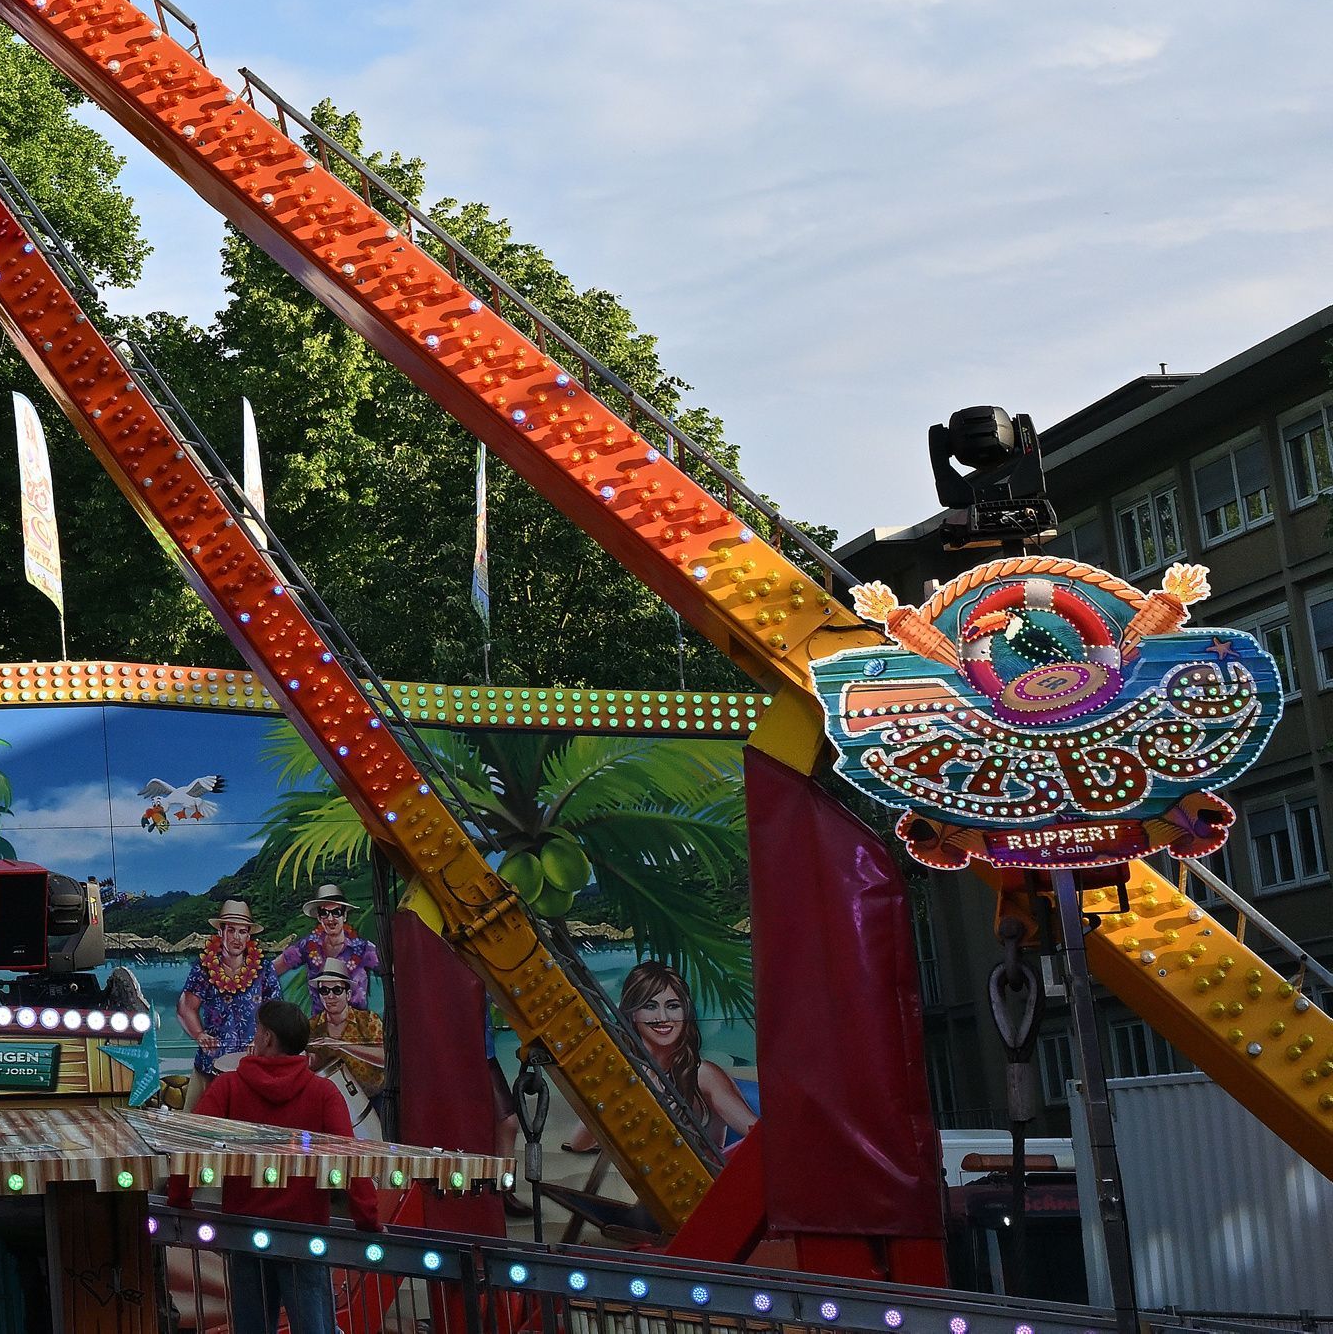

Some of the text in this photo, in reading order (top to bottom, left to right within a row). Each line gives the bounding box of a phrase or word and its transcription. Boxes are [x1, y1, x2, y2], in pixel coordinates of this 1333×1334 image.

[1035, 675, 1067, 691] ER
[1006, 824, 1120, 852] RUPPERT
[1040, 843, 1094, 858] & Sohn
